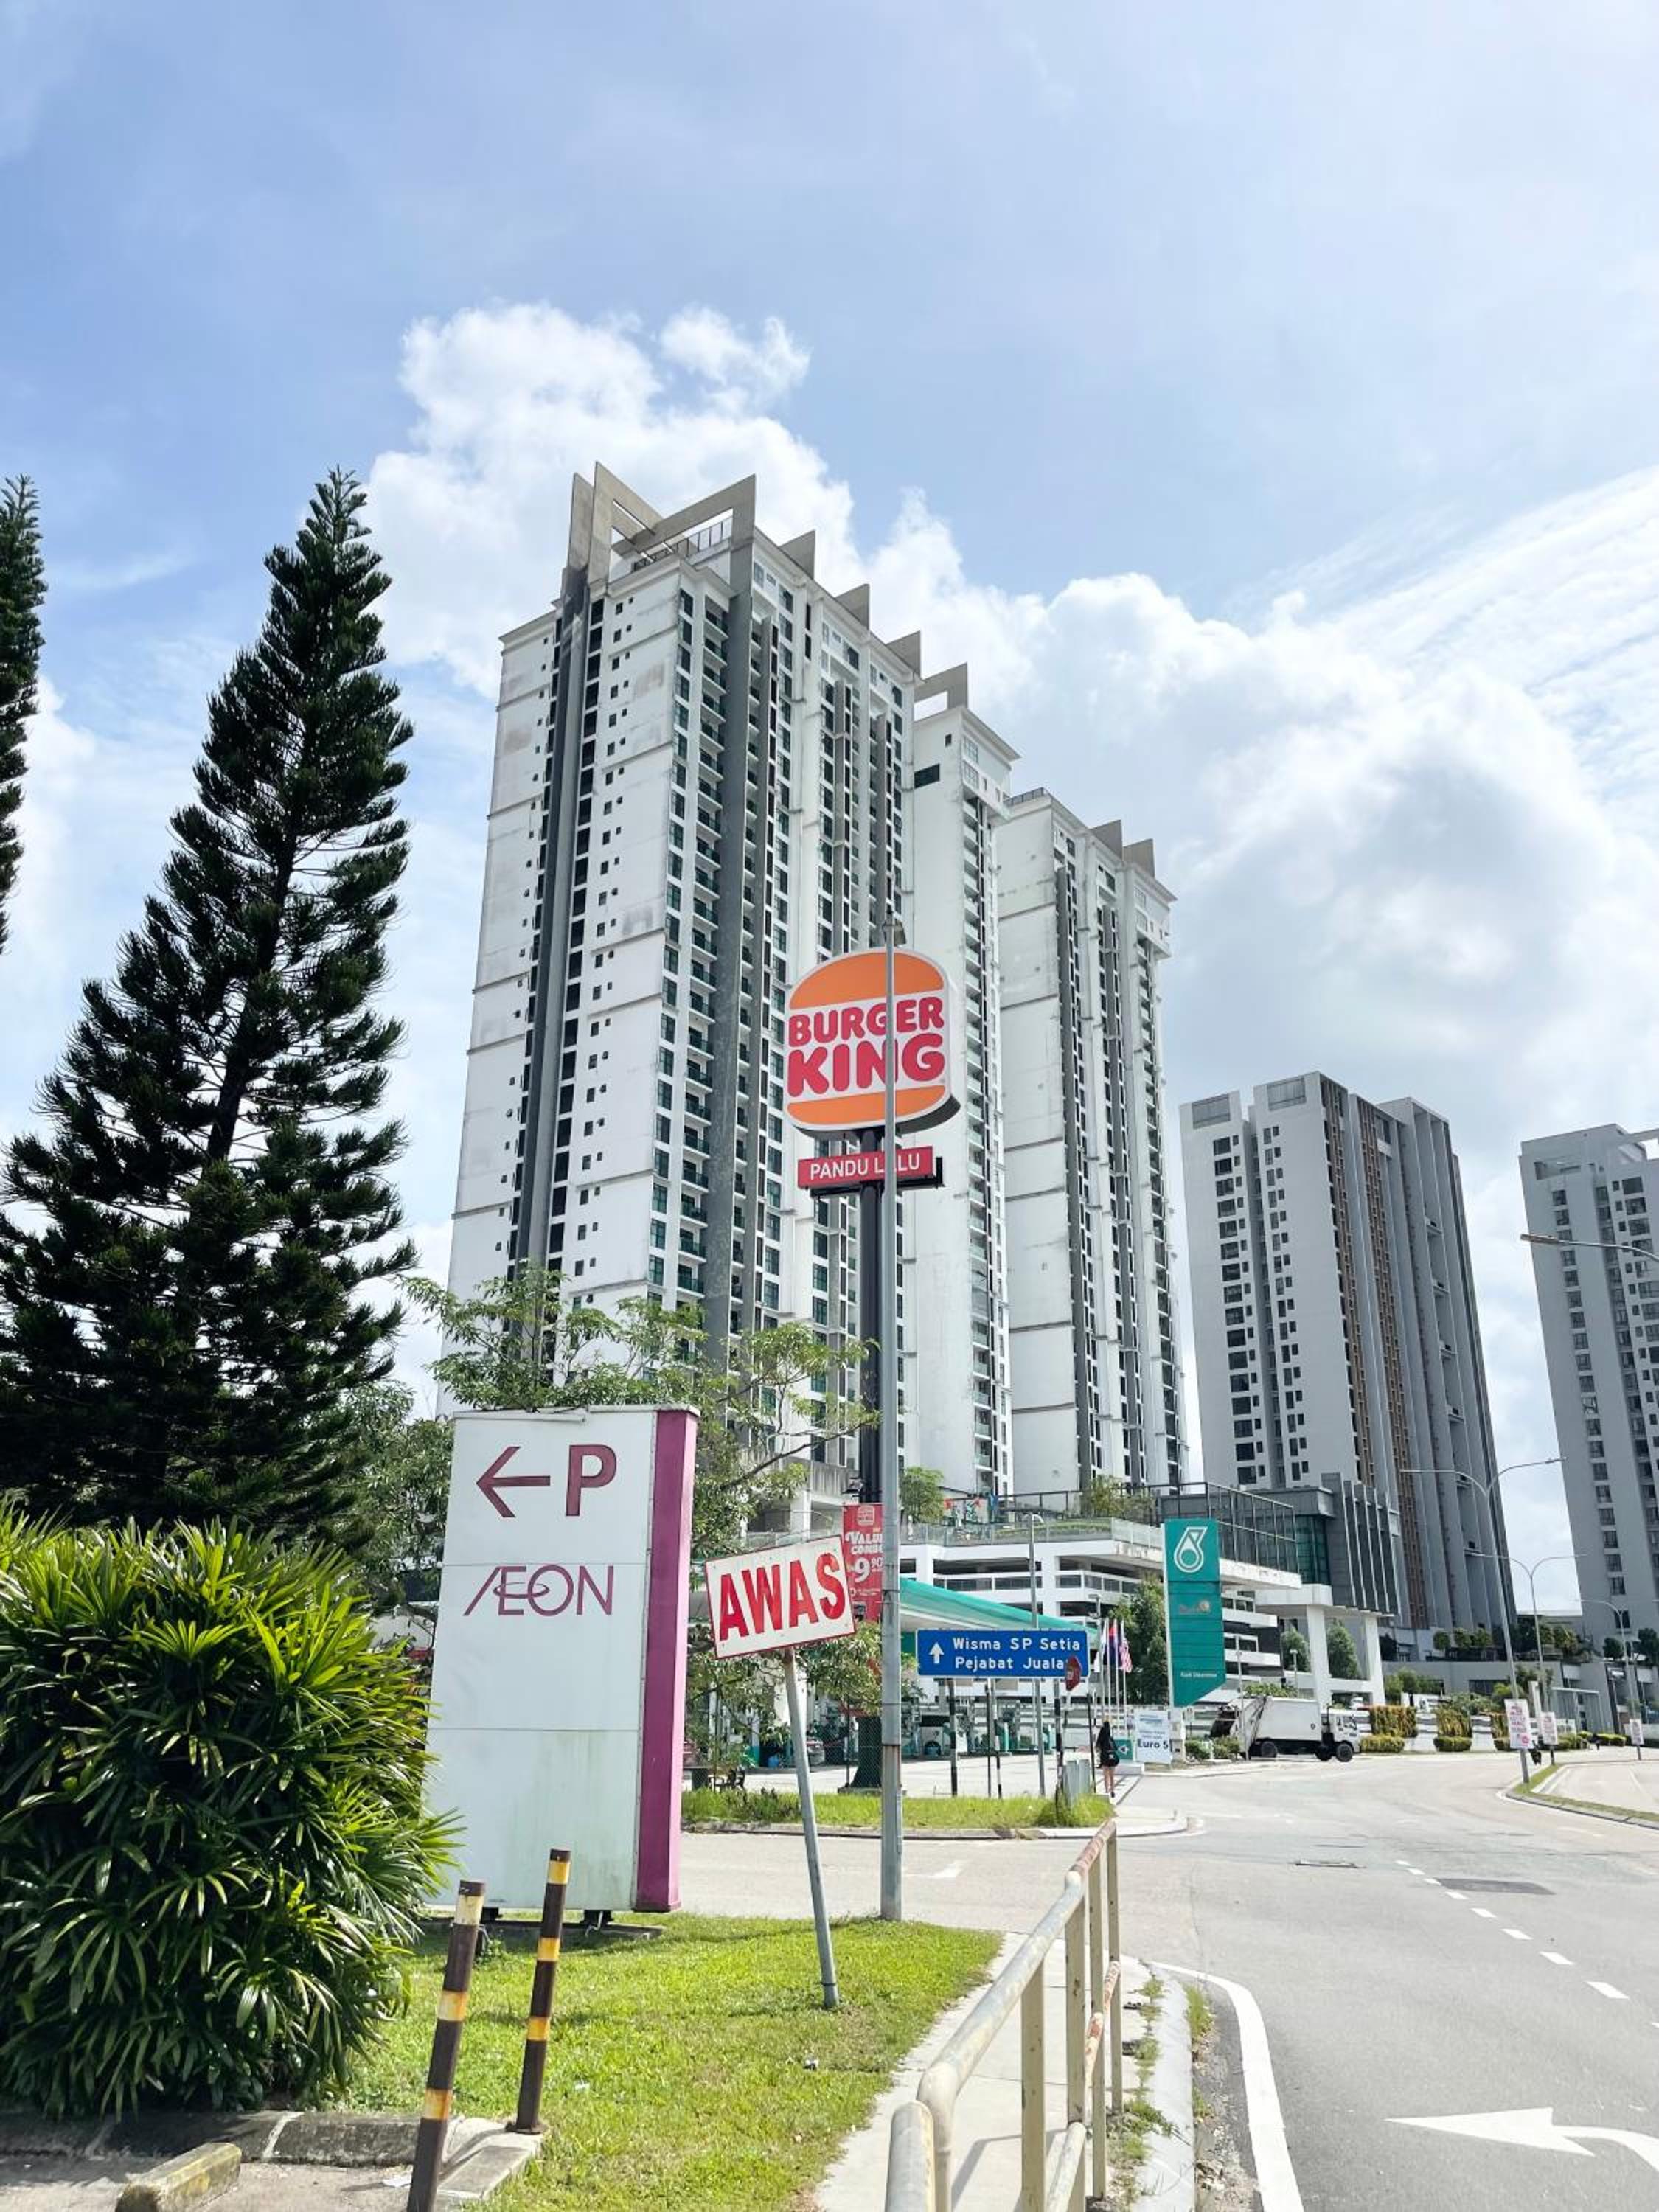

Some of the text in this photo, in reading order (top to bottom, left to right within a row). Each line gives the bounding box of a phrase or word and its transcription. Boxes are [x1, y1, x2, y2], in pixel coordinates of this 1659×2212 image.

[788, 997, 945, 1048] BURGER
[787, 1033, 945, 1097] KING
[810, 1153, 920, 1180] PANDU LLU
[565, 1444, 618, 1517] P
[718, 1552, 846, 1641] AWAS
[952, 1637, 1081, 1651] Wisma SP Setia
[955, 1656, 1067, 1672] Pejabat Juala
[1137, 1739, 1161, 1748] Euro
